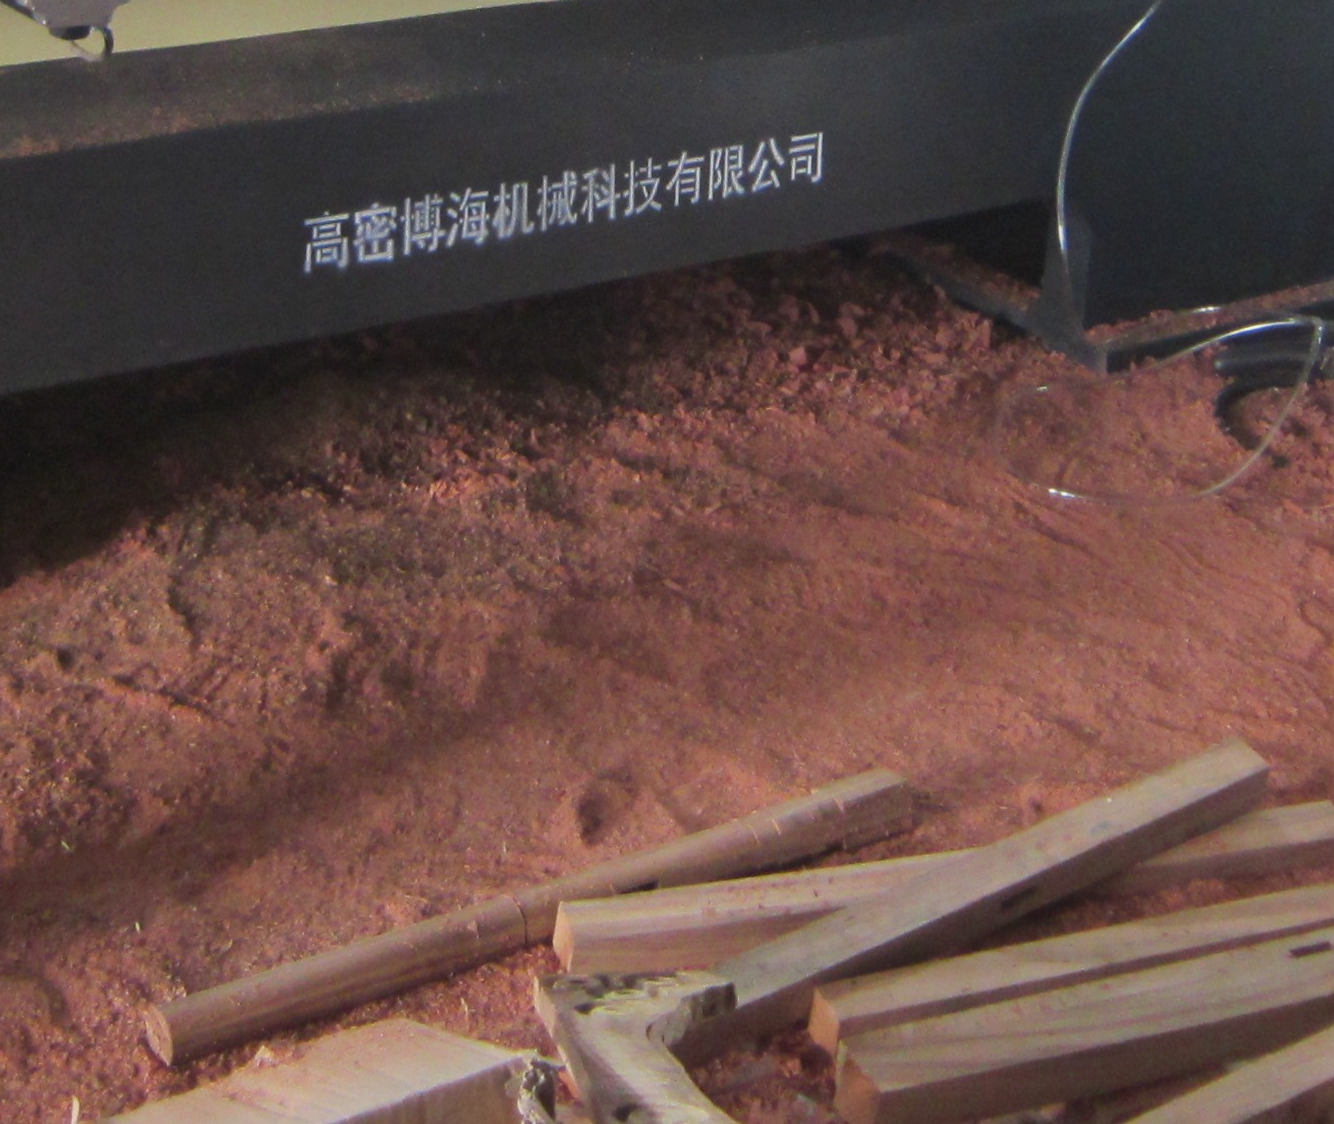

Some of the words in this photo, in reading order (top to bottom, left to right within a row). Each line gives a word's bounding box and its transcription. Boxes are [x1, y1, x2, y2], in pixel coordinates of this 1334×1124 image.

[304, 131, 824, 273] 高密博海机械科技有限公司
